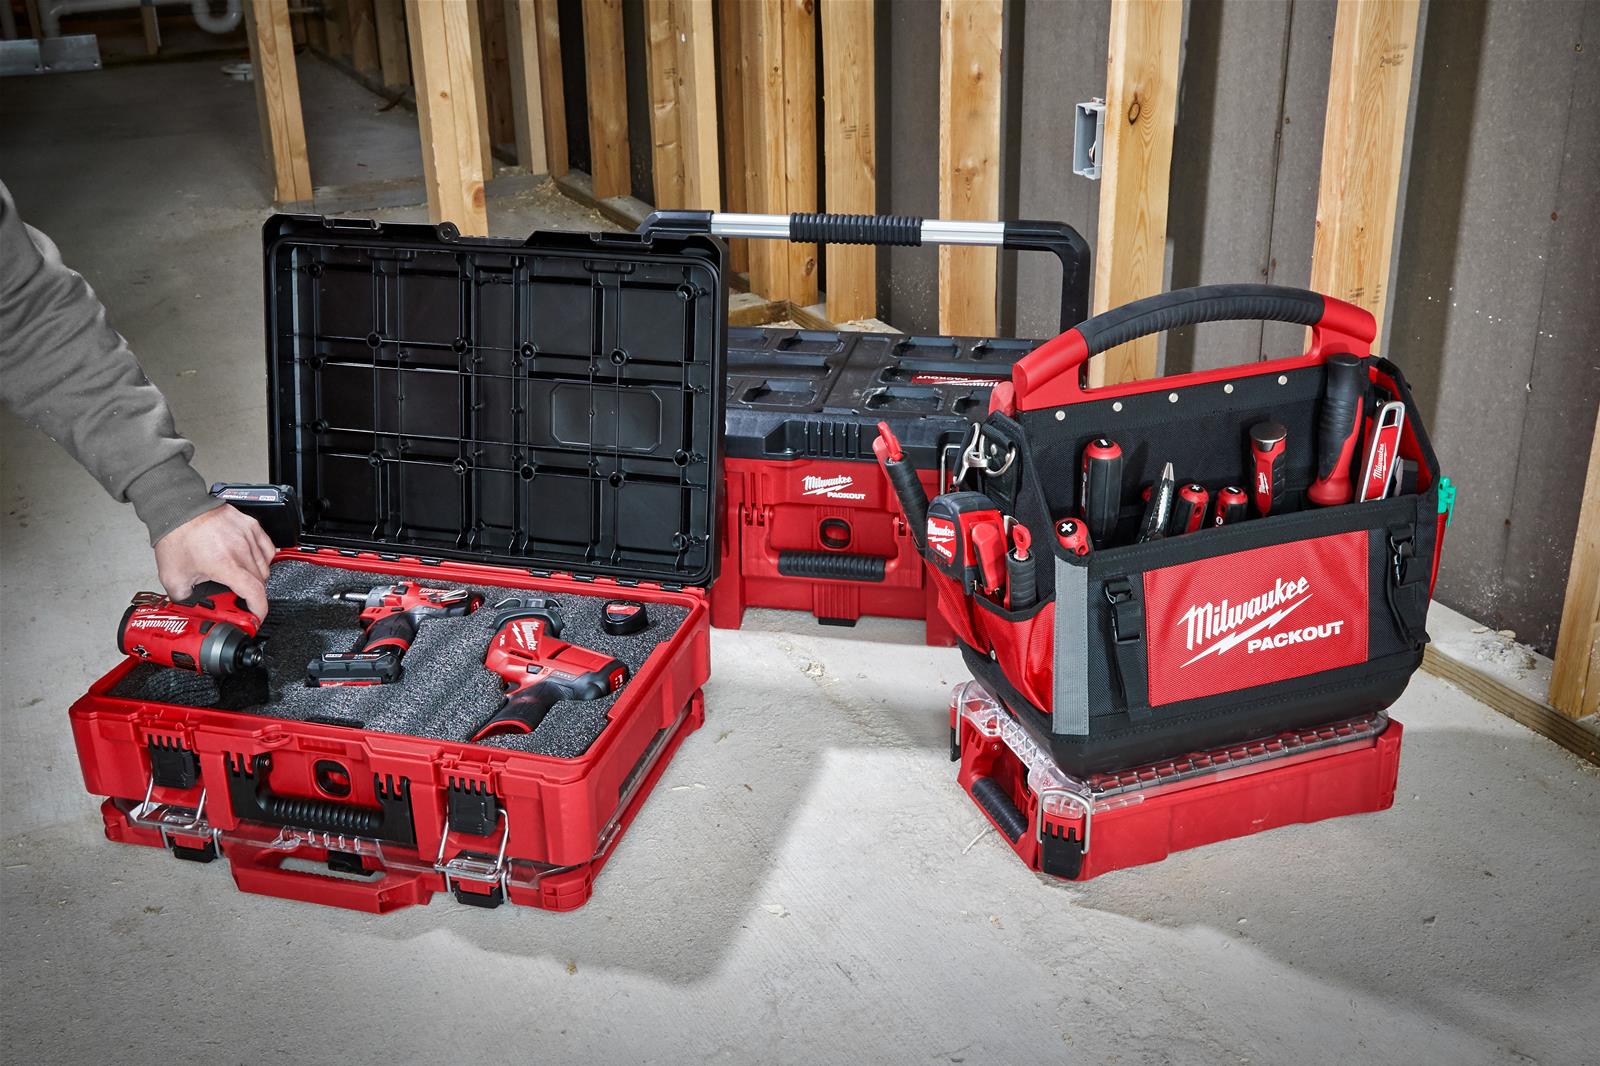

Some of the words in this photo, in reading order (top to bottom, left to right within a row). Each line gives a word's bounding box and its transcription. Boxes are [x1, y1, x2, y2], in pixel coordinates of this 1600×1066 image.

[1373, 443, 1385, 480] Milwaukee
[801, 475, 853, 490] Milwaukee
[827, 491, 866, 500] PACKOUT
[1176, 576, 1310, 651] Milwaukee
[131, 619, 189, 635] Milwaukee
[1247, 620, 1344, 654] PACKOUT
